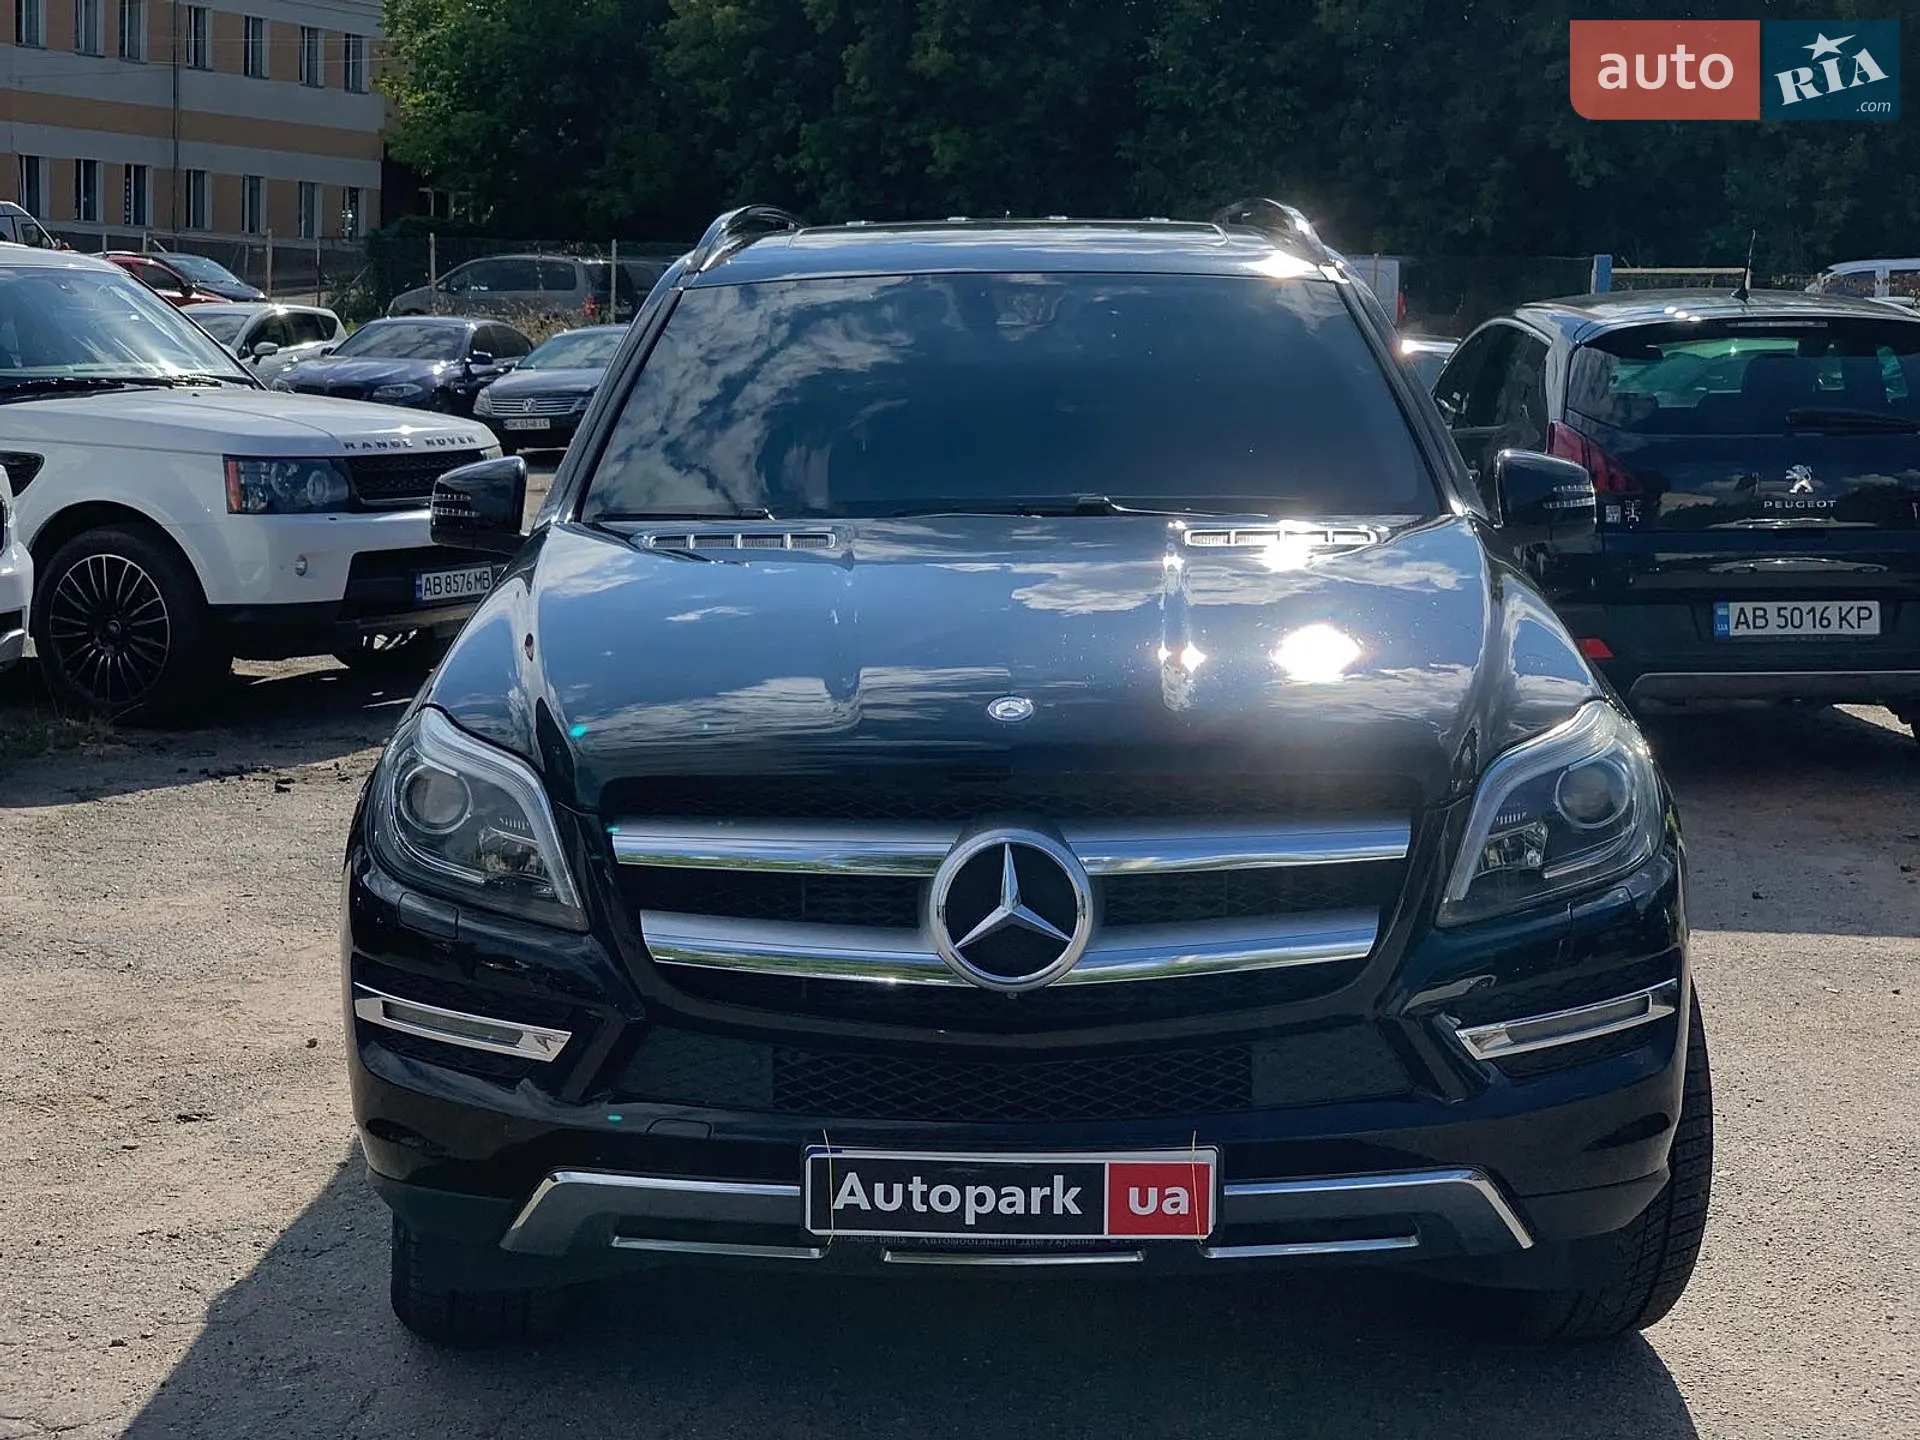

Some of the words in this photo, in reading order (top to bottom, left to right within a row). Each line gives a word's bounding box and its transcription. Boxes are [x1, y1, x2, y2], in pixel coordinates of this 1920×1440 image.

[343, 438, 413, 450] RANGE
[424, 435, 476, 447] ROVER
[1763, 500, 1837, 509] PEUGEOT
[424, 575, 443, 596] AB
[445, 573, 472, 594] 8576
[474, 570, 491, 591] MB
[1734, 606, 1769, 630] AB
[1776, 605, 1832, 630] 5016
[1838, 605, 1873, 629] KP
[832, 1171, 1083, 1226] Autopark
[1128, 1186, 1189, 1216] ua
